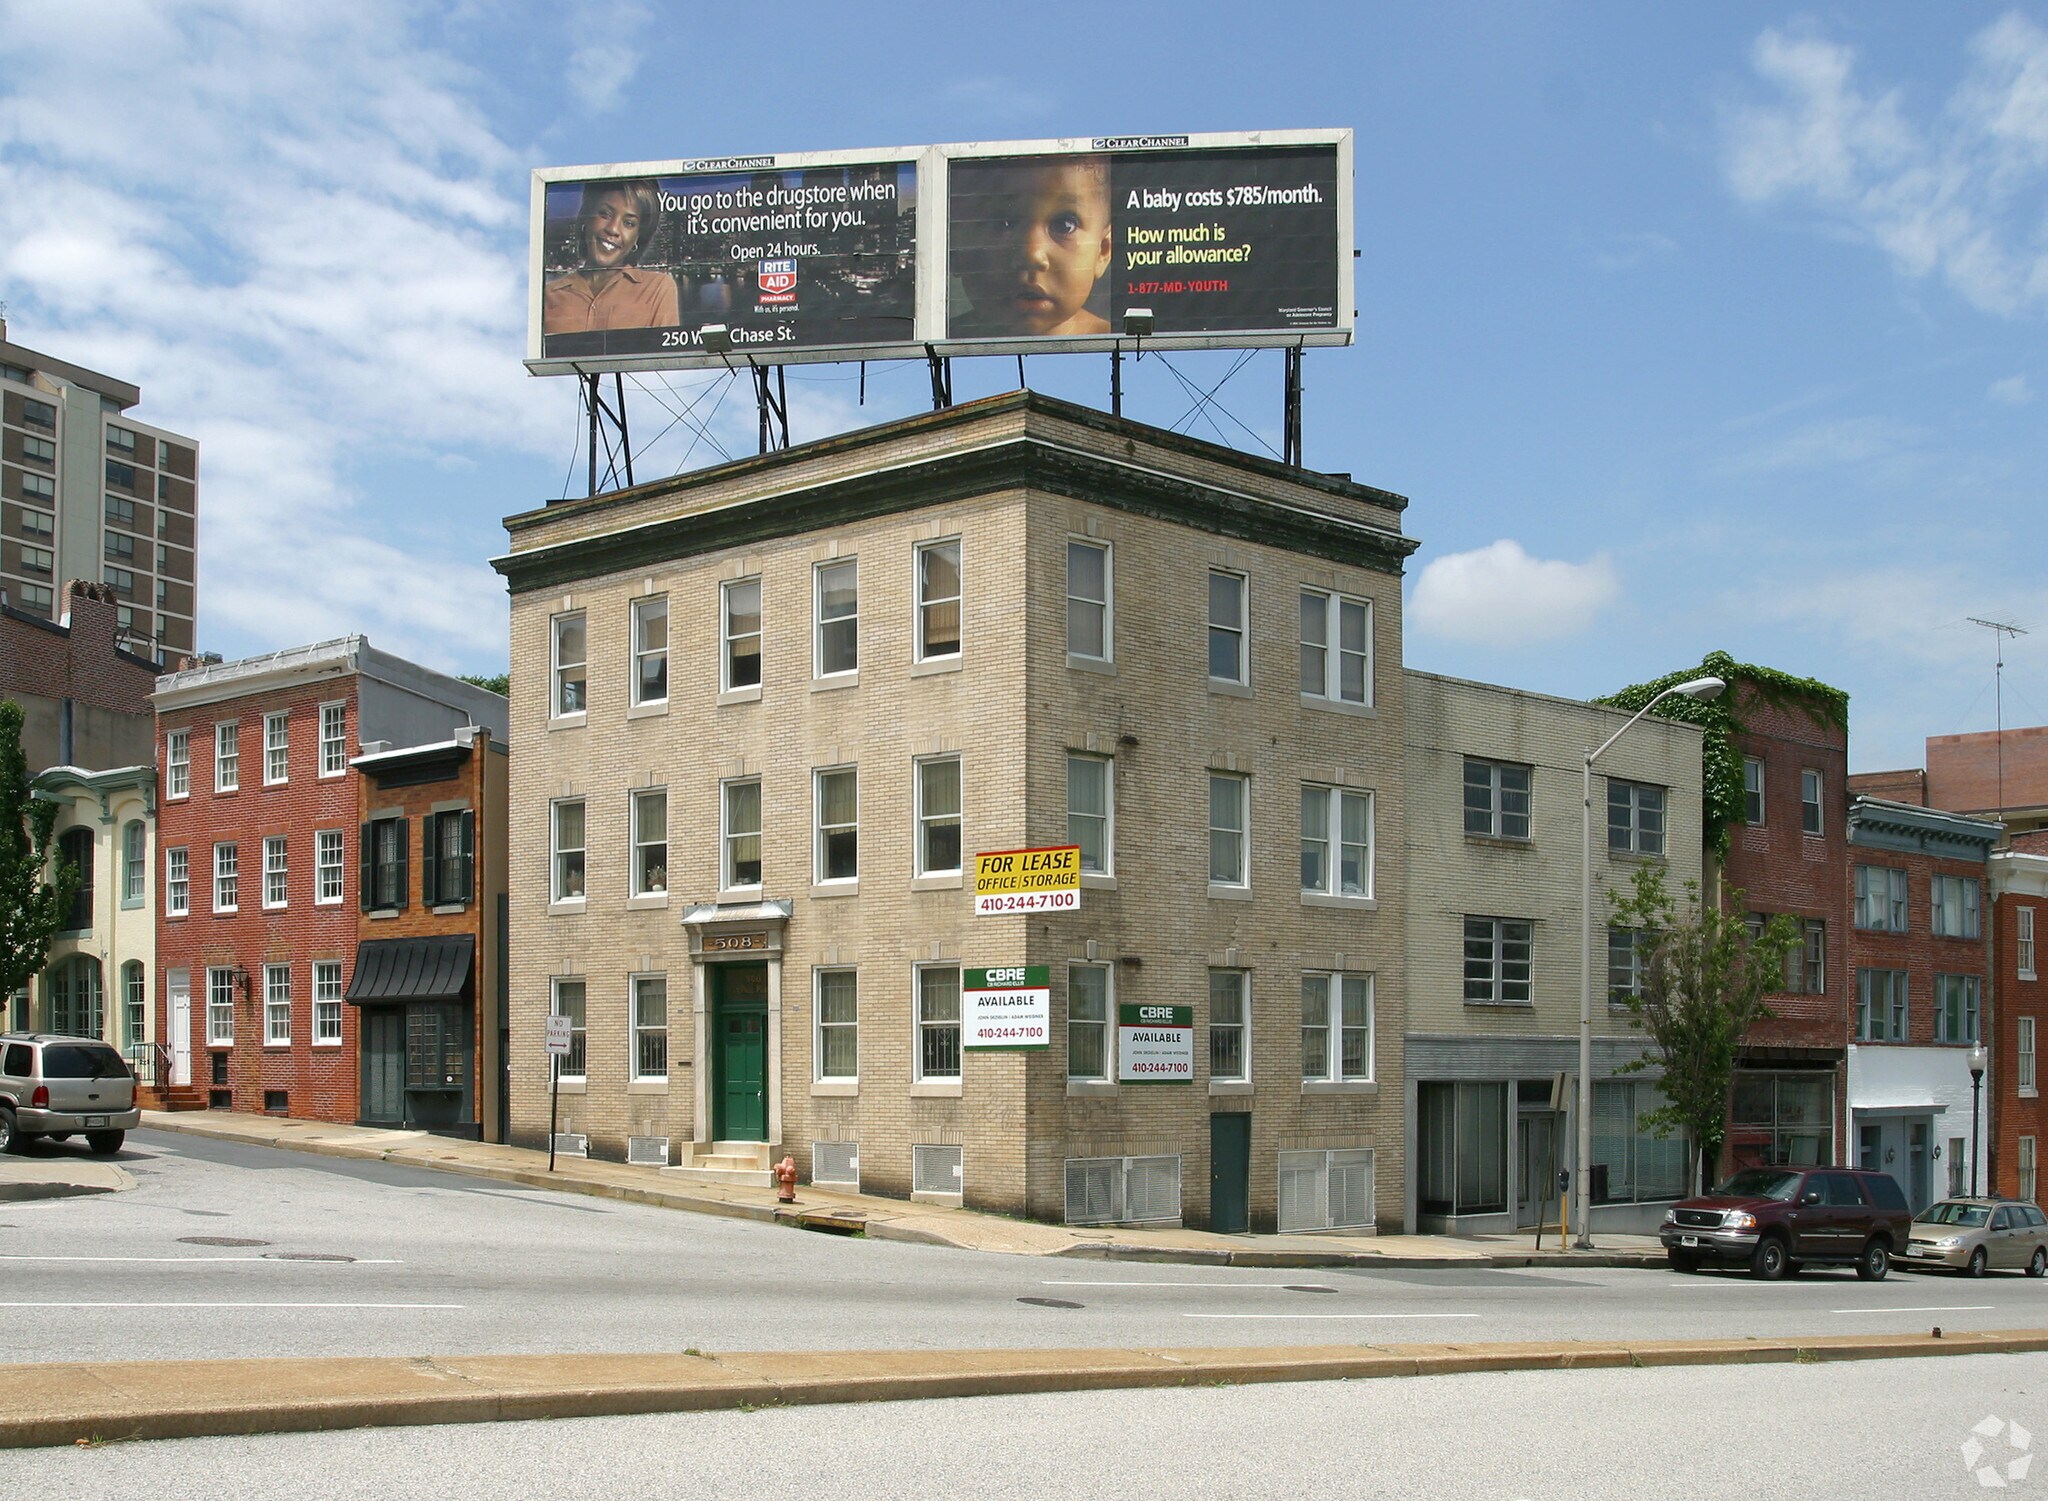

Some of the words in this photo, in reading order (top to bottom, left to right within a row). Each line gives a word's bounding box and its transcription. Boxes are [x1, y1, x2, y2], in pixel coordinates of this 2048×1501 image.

[656, 191, 687, 212] You
[690, 194, 713, 216] go
[715, 191, 732, 209] to
[735, 186, 763, 208] the
[766, 184, 846, 209] drugstore
[850, 179, 896, 201] when
[1126, 190, 1140, 209] A
[1143, 188, 1182, 212] baby
[1185, 188, 1223, 207] costs
[1226, 183, 1323, 207] $785/month.
[687, 213, 708, 235] it's
[711, 209, 802, 234] convenient
[805, 206, 829, 229] for
[831, 210, 866, 232] you.
[1127, 226, 1164, 244] How
[1168, 223, 1210, 243] much
[1213, 223, 1225, 241] is
[730, 244, 764, 263] Open
[766, 242, 782, 258] 24
[784, 241, 821, 257] hours.
[1126, 249, 1162, 270] your
[1165, 244, 1252, 264] allowance?
[764, 261, 791, 273] RITE
[766, 276, 789, 288] AID
[1127, 280, 1228, 294] 1-877-MD-YOUTH
[661, 331, 689, 347] 250
[730, 328, 774, 343] Chase
[776, 325, 796, 341] St.
[981, 856, 1014, 874] FOR
[1021, 851, 1073, 872] LEASE
[980, 893, 1074, 911] 410-244-7100
[986, 968, 1026, 982] CBRE
[977, 995, 1035, 1007] AVAILABLE
[1139, 1006, 1174, 1019] CBRE
[547, 1030, 570, 1038] PARKING
[977, 1026, 1043, 1038] 410-244-7100
[1132, 1032, 1182, 1043] AVAILABLE
[1132, 1062, 1189, 1073] 410-244-7100
